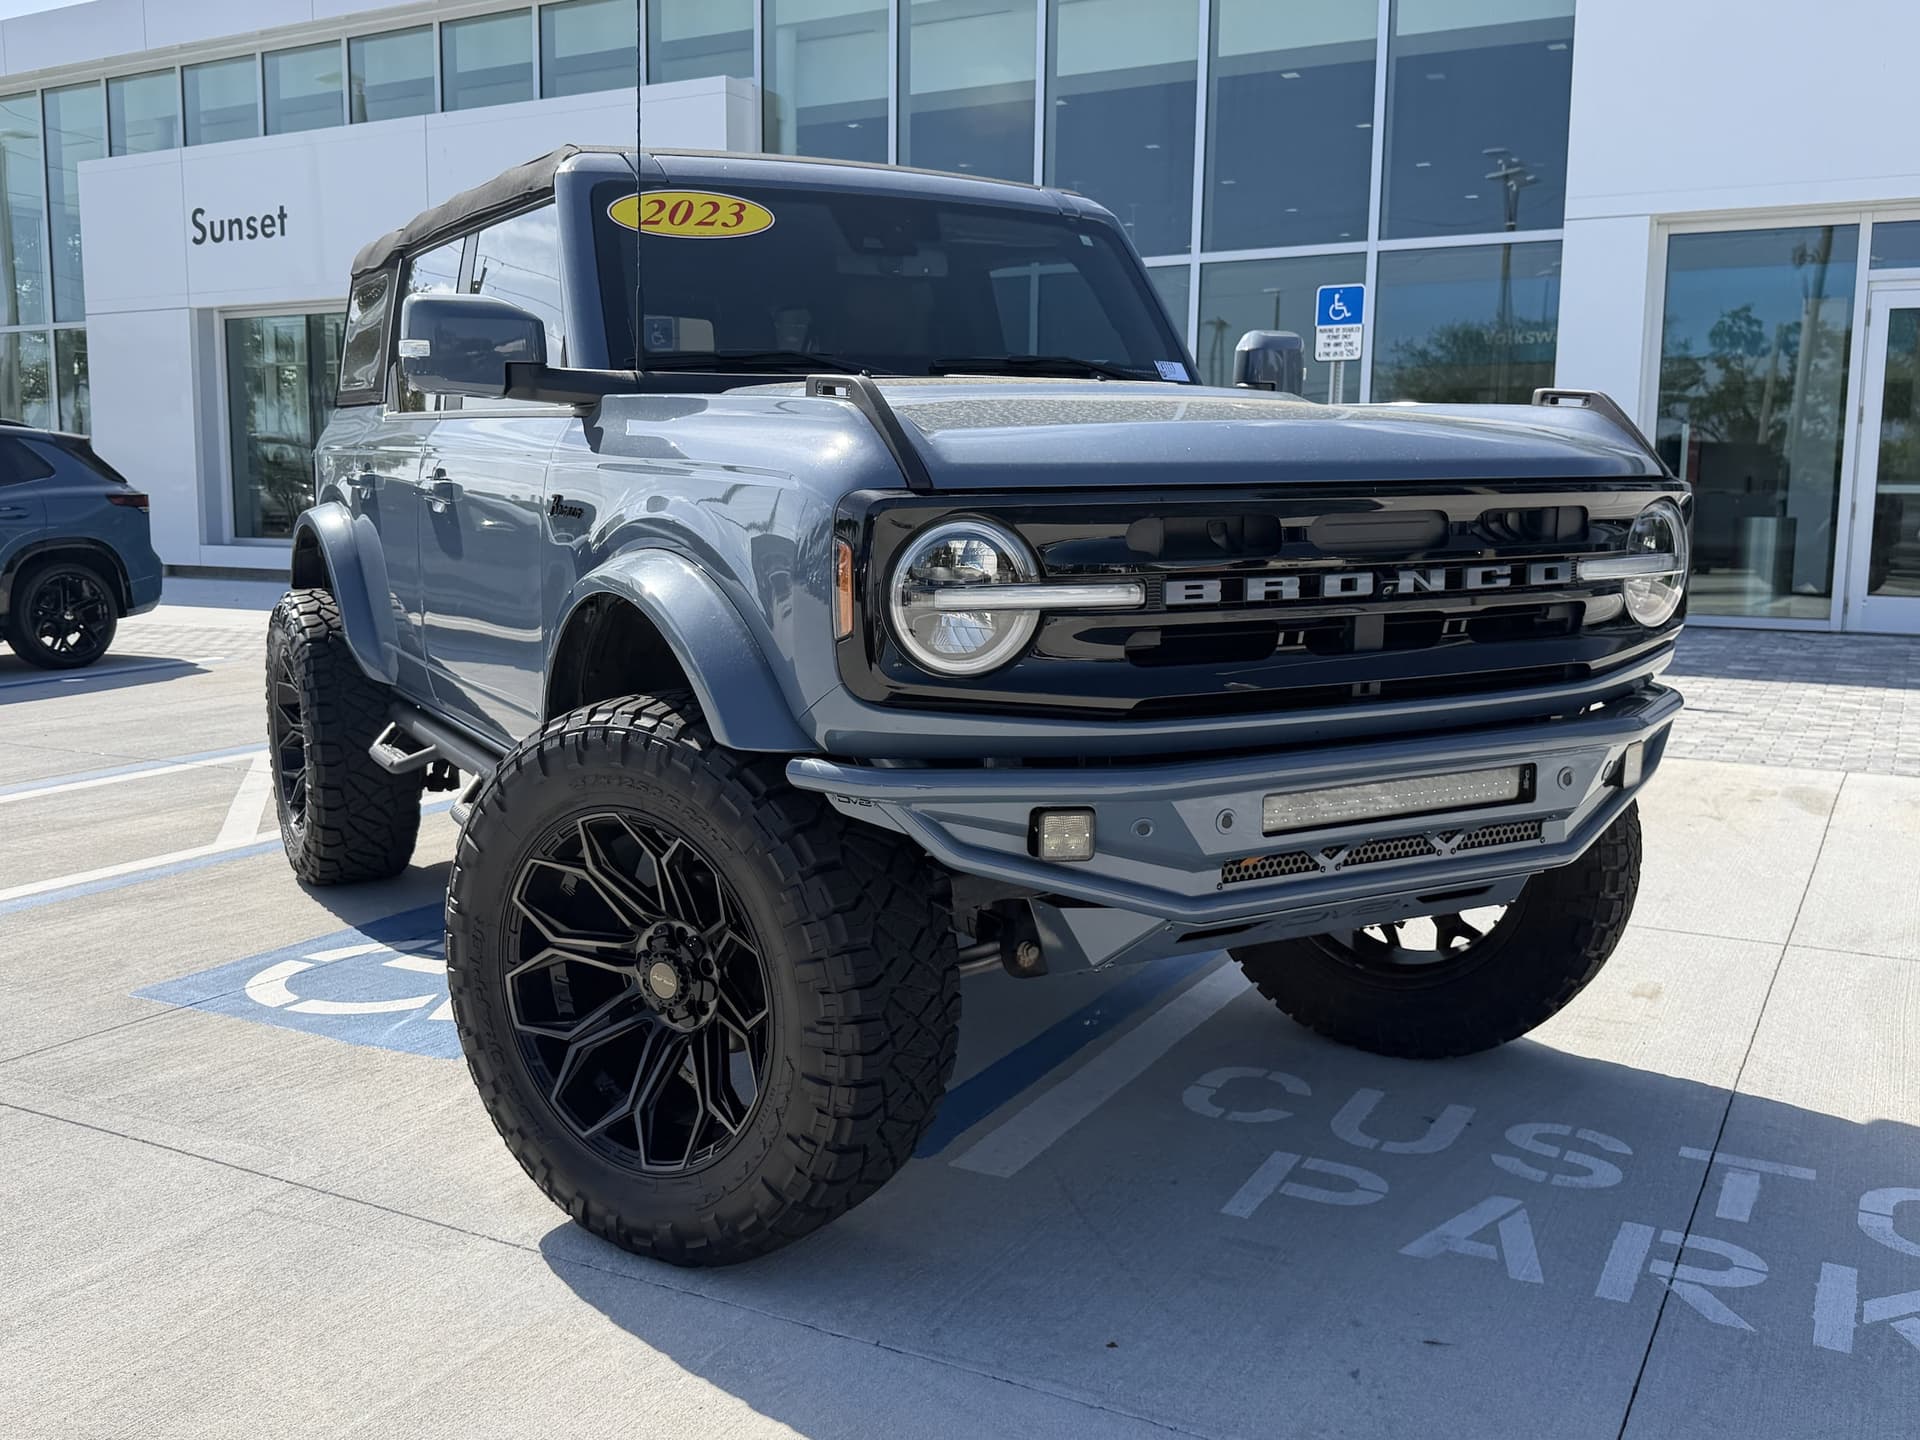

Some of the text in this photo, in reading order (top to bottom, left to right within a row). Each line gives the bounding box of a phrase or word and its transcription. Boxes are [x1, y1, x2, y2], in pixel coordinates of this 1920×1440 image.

[191, 205, 288, 245] Sunset
[641, 199, 747, 228] 2023
[1166, 563, 1571, 605] BRONCO
[1221, 1150, 1920, 1354] PARK
